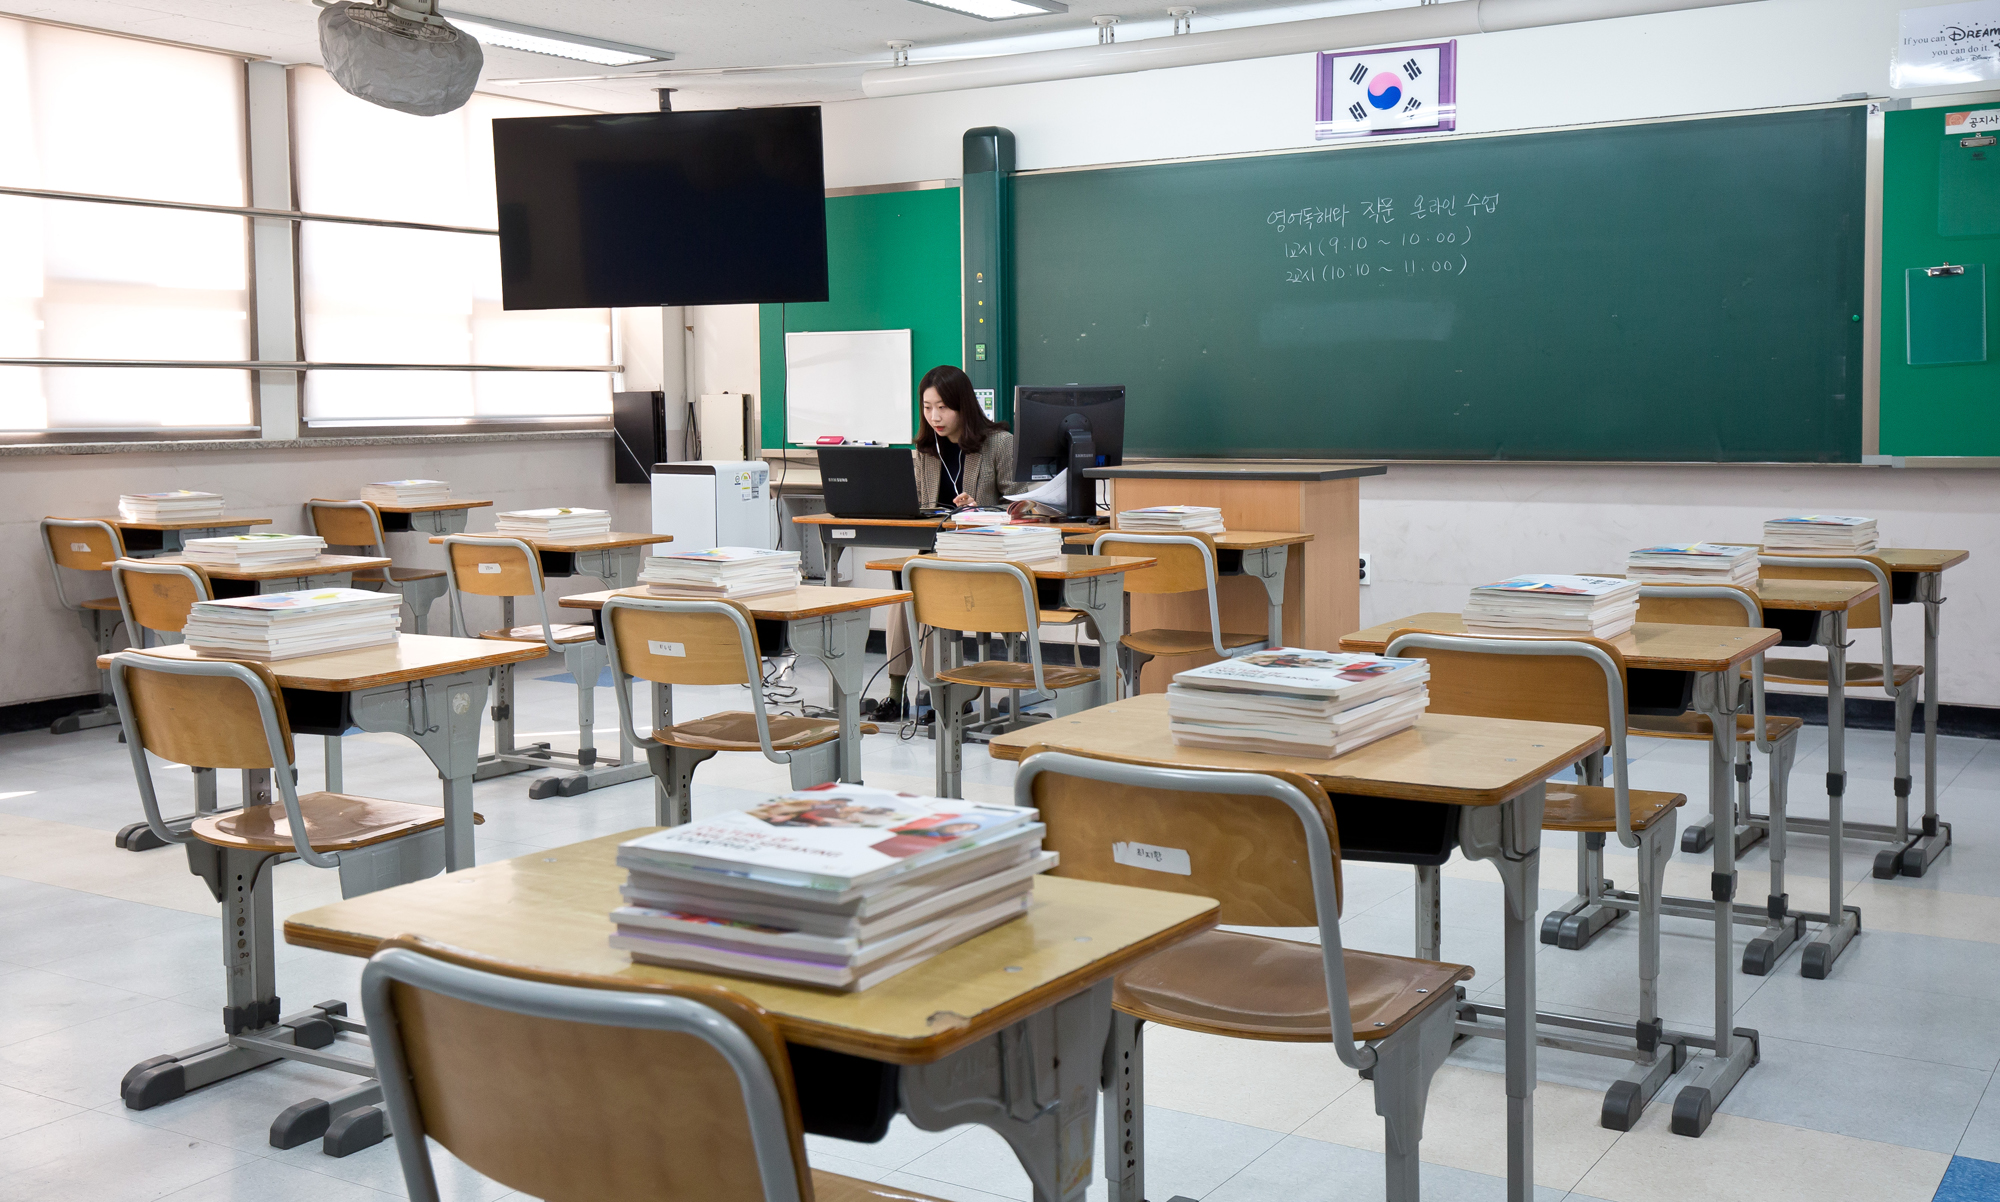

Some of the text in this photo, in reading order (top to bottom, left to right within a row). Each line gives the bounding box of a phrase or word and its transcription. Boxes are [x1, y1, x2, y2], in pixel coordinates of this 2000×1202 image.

[1903, 37, 1912, 45] If
[1913, 37, 1929, 46] you
[1930, 35, 1946, 43] can
[1932, 49, 1948, 58] you
[1950, 47, 1966, 55] can
[1967, 45, 1979, 53] do
[1969, 114, 2000, 128] 공지사
[1409, 195, 1457, 220] 온라인
[1464, 193, 1499, 216] 수업
